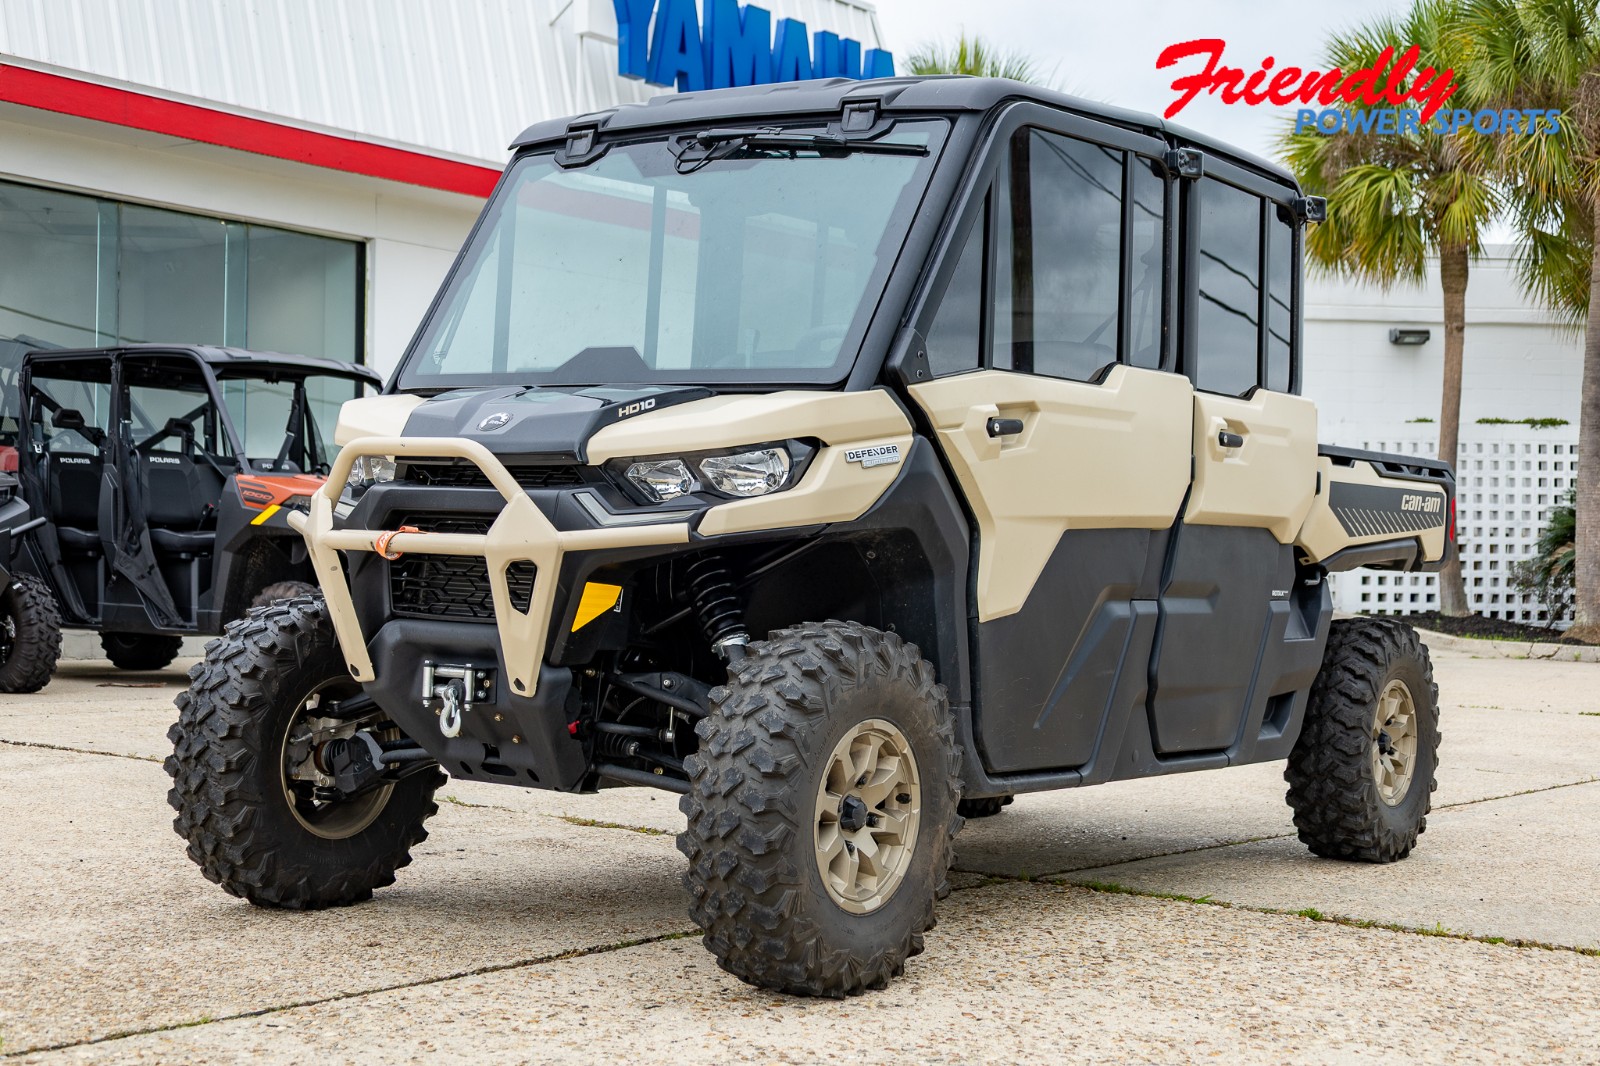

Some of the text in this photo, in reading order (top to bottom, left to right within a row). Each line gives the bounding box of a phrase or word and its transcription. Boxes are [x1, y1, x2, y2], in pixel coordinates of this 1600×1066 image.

[614, 0, 895, 93] YAMAH
[618, 398, 656, 417] HD10
[149, 456, 181, 464] POLARIS
[848, 445, 898, 460] DEFENDER
[243, 490, 273, 501] 1000
